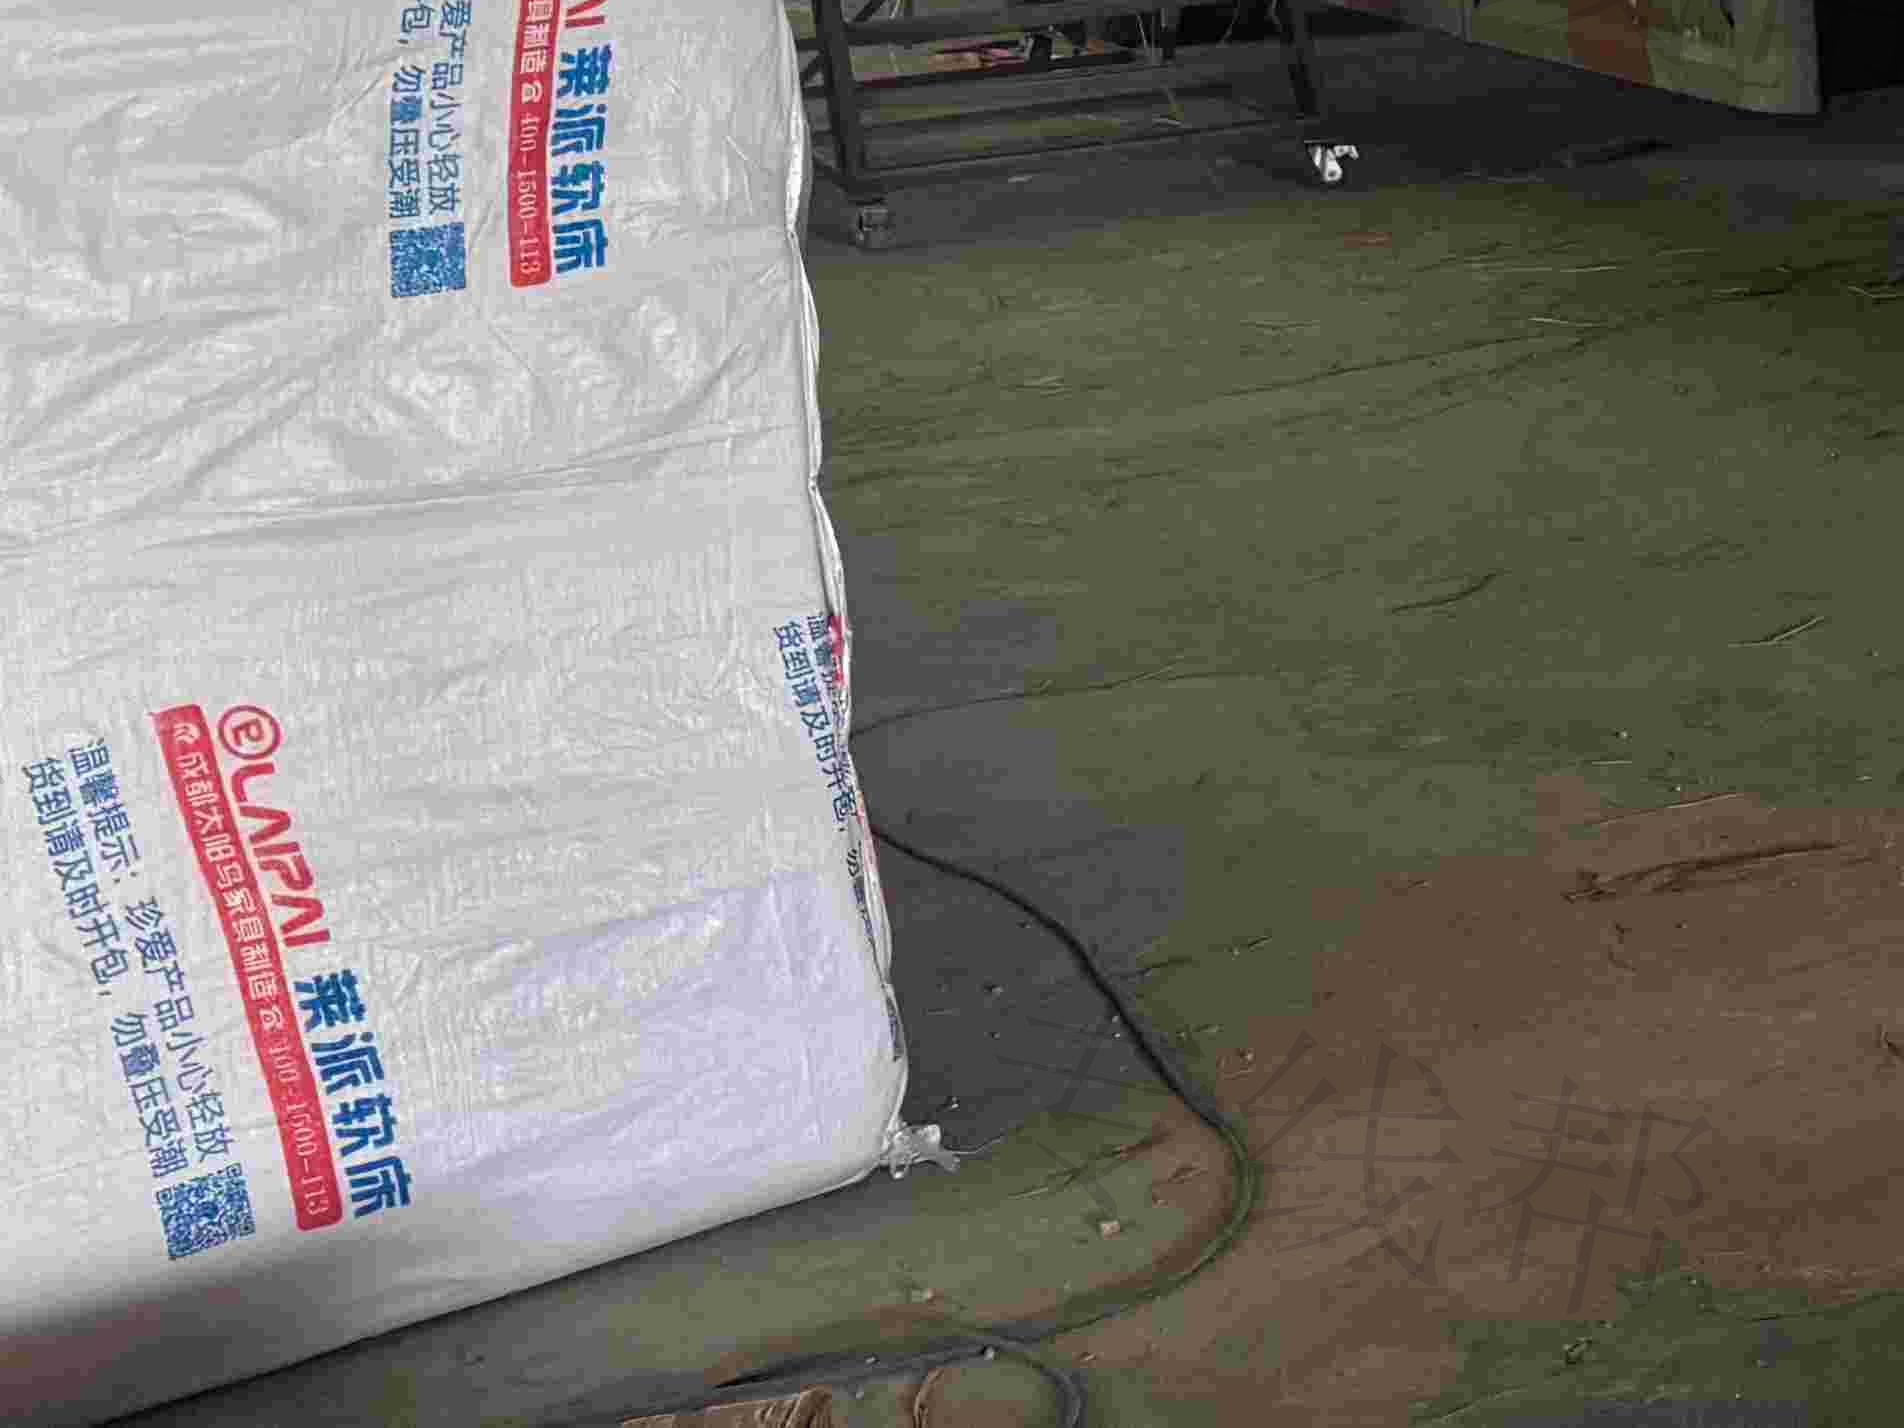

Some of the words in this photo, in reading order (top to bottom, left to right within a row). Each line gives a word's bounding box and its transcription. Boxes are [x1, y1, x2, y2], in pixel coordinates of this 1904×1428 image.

[551, 43, 613, 276] 莱派软床
[230, 764, 332, 947] LAIPAI
[295, 970, 411, 1219] 莱派软床
